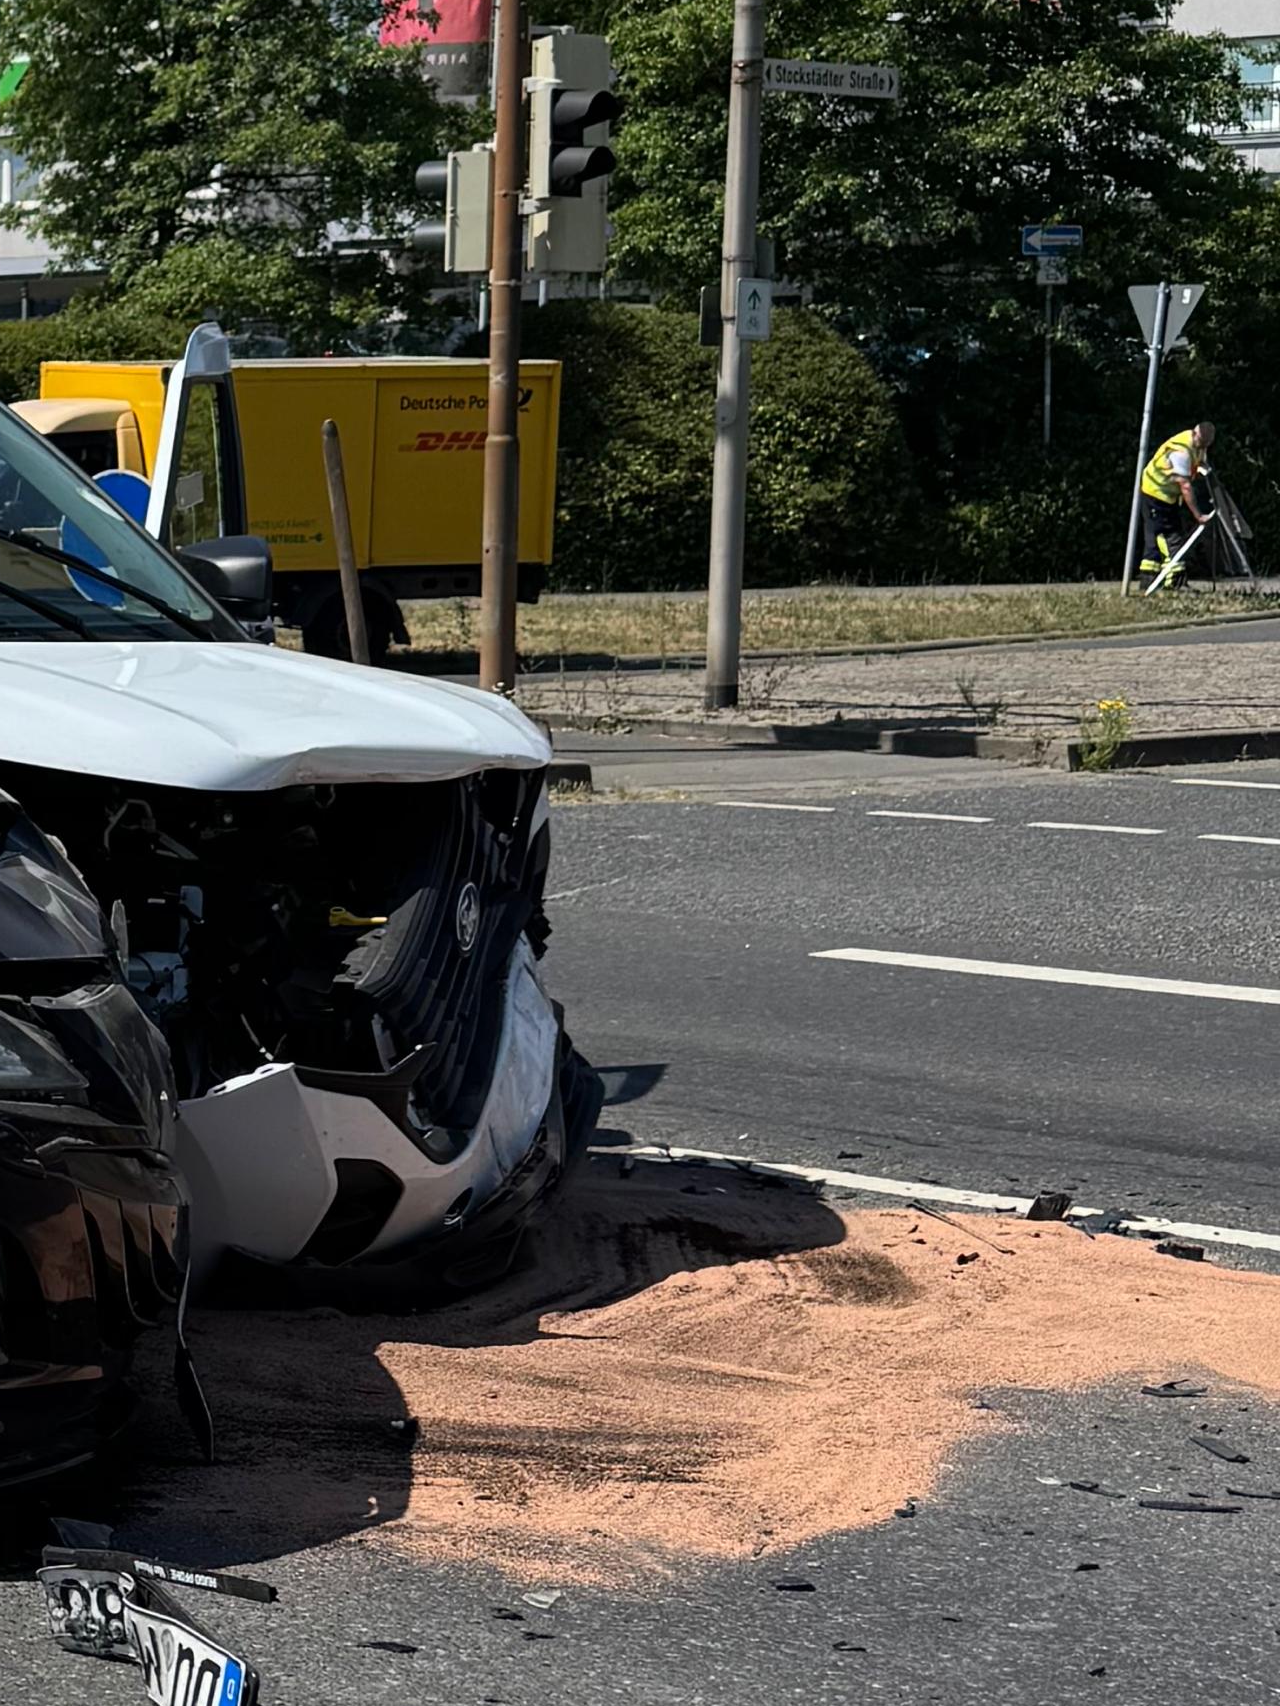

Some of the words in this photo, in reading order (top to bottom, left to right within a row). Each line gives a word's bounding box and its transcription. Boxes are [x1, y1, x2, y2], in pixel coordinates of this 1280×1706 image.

[775, 65, 844, 88] Stockstädter
[850, 70, 886, 91] Straße
[400, 395, 466, 410] Deutsche
[469, 395, 489, 410] Po
